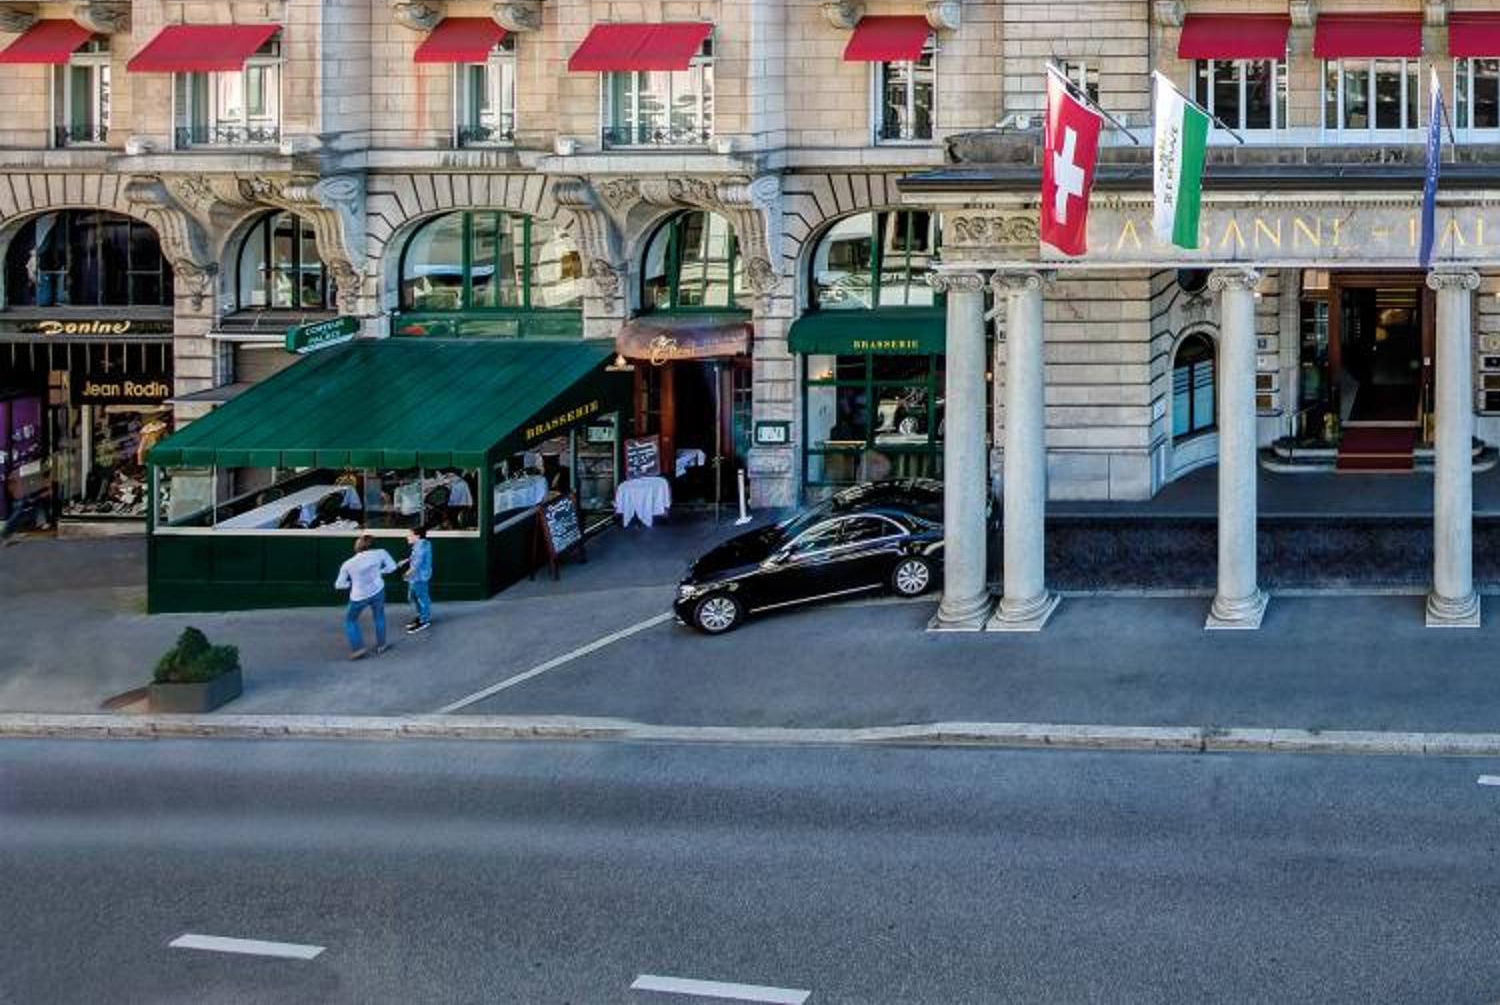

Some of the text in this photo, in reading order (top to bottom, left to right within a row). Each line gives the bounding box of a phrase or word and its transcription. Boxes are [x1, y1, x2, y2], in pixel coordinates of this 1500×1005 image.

[853, 339, 919, 349] BRASSERIE
[82, 381, 169, 397] Jean Rodin
[526, 399, 600, 441] BRASSERIE
